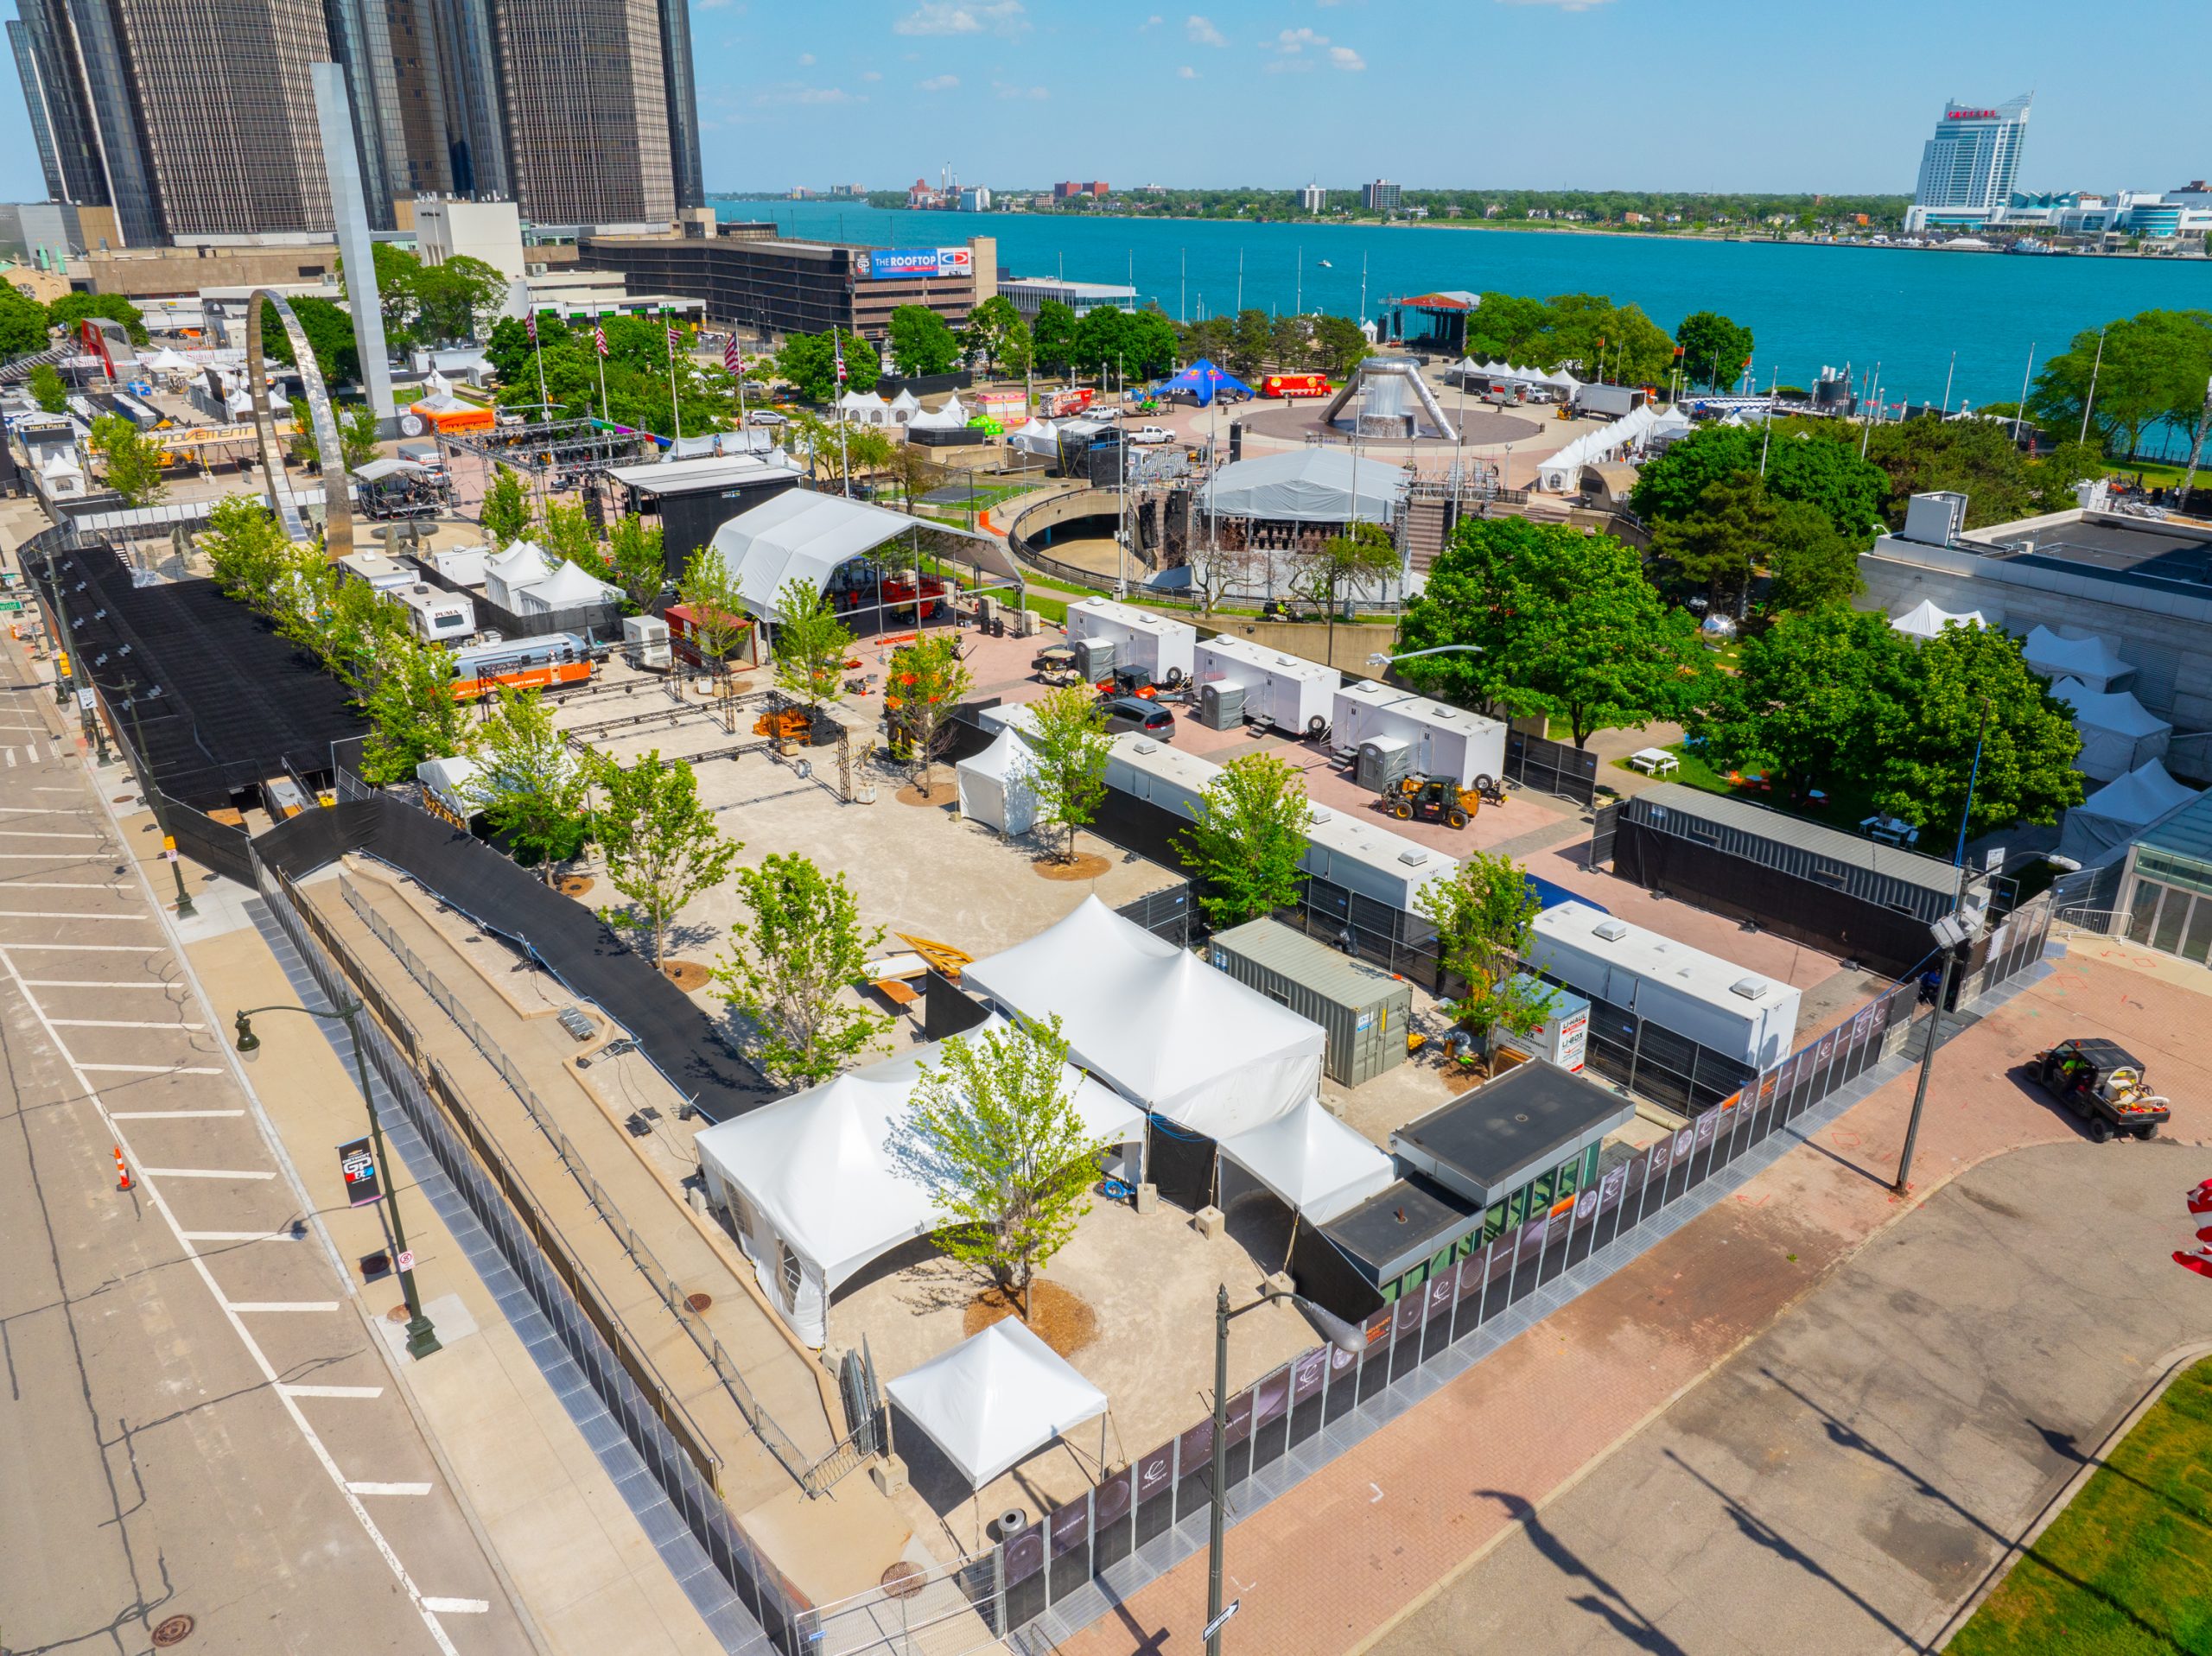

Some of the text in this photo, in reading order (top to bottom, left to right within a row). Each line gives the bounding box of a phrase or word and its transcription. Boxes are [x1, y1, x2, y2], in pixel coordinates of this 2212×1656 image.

[891, 256, 936, 266] ROOFTOP
[158, 425, 252, 443] MOVEMENT
[435, 609, 459, 618] PUMA
[1562, 1031, 1583, 1048] U-BOX
[344, 1157, 372, 1174] GP
[1217, 1613, 1228, 1624] WAY
